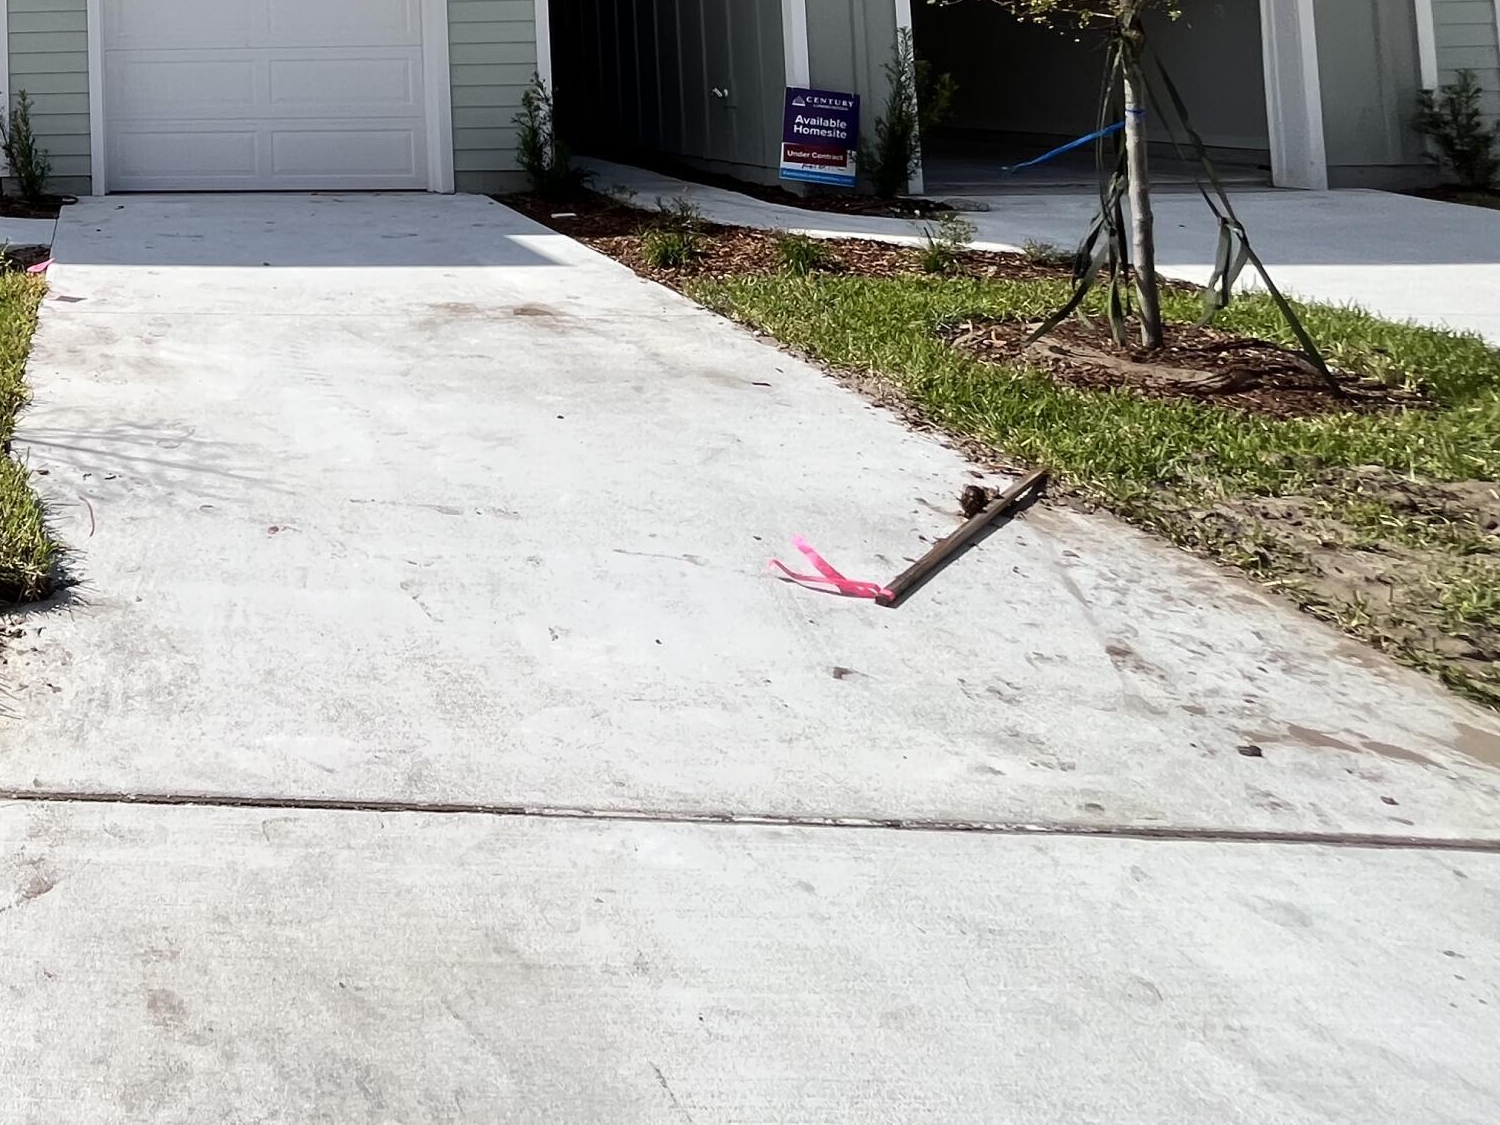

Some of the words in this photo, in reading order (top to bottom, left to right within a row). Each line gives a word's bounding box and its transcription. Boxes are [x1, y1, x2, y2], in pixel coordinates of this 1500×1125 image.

[806, 96, 854, 107] CENTURY
[794, 115, 847, 129] Available
[793, 124, 847, 139] Homesite
[787, 150, 810, 158] Under
[811, 152, 843, 161] Contract
